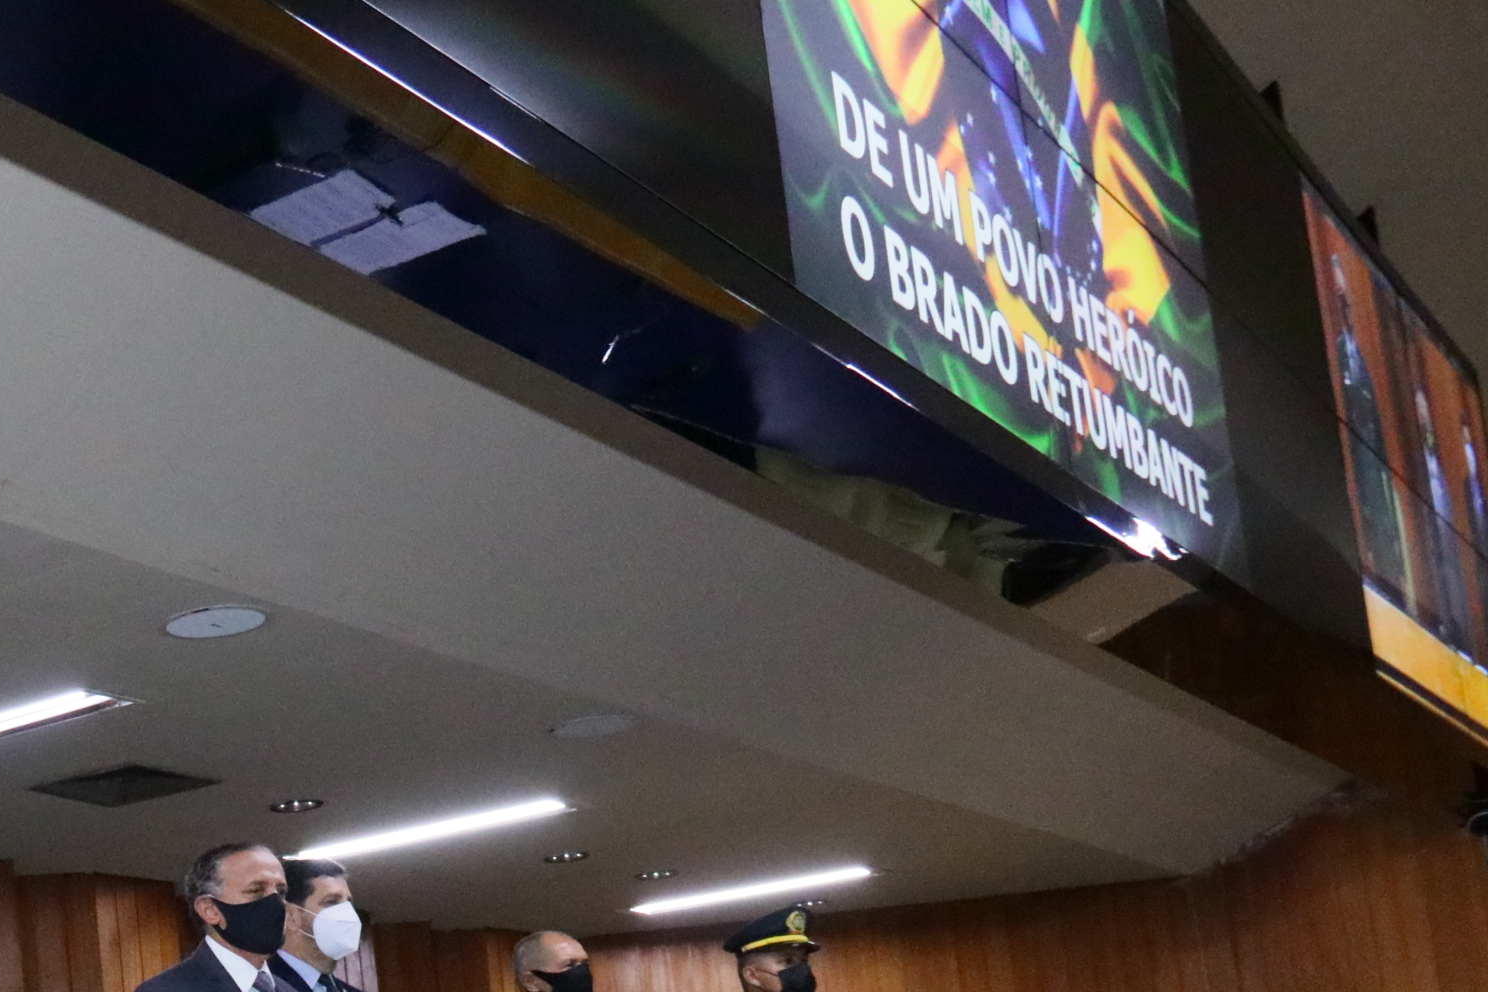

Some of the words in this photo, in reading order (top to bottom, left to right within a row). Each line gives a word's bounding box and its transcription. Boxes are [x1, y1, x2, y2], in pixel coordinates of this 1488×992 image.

[831, 71, 894, 188] DE
[898, 128, 964, 246] UM
[970, 190, 1064, 324] POVO
[1068, 281, 1194, 428] HERÓICO
[840, 196, 874, 282] O
[884, 224, 1018, 386] BRADO
[1024, 331, 1214, 527] RETUMBANTE
